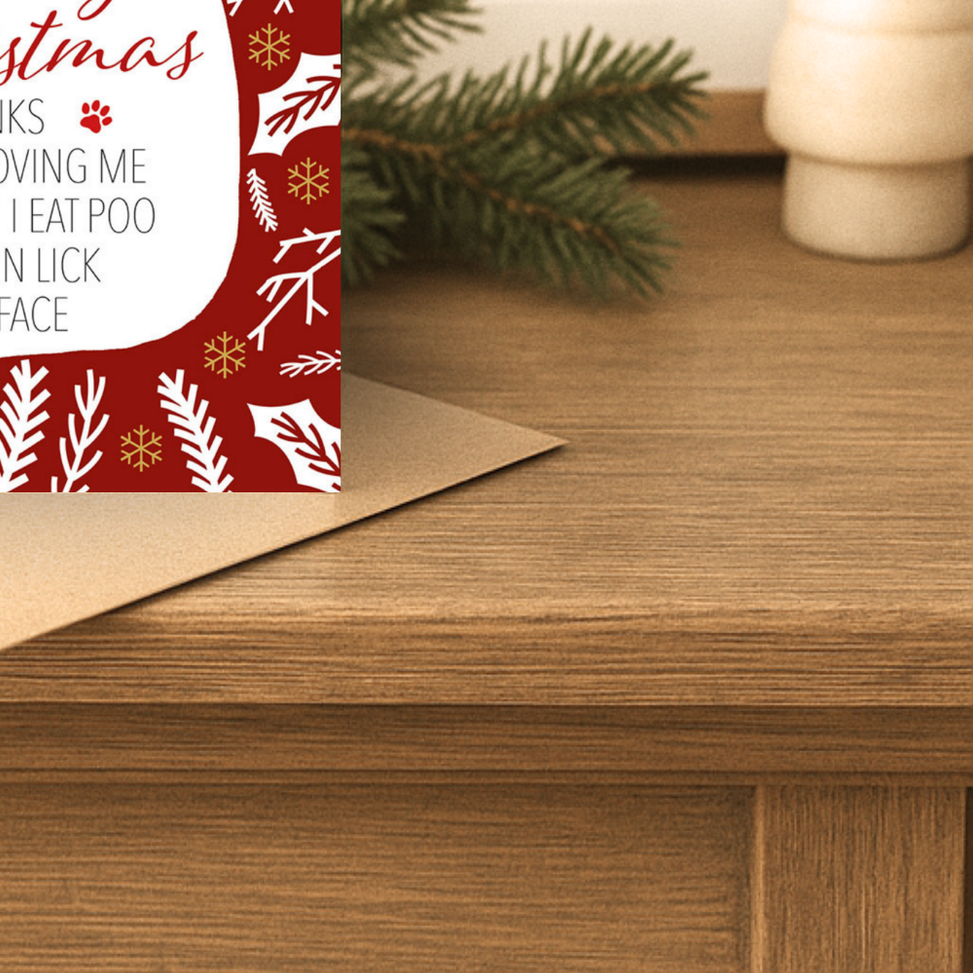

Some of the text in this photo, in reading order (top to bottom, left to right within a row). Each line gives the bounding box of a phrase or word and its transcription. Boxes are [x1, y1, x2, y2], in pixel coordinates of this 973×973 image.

[100, 149, 146, 183] ME
[31, 198, 79, 233] EAT
[89, 197, 155, 234] POO
[38, 247, 101, 283] LICK
